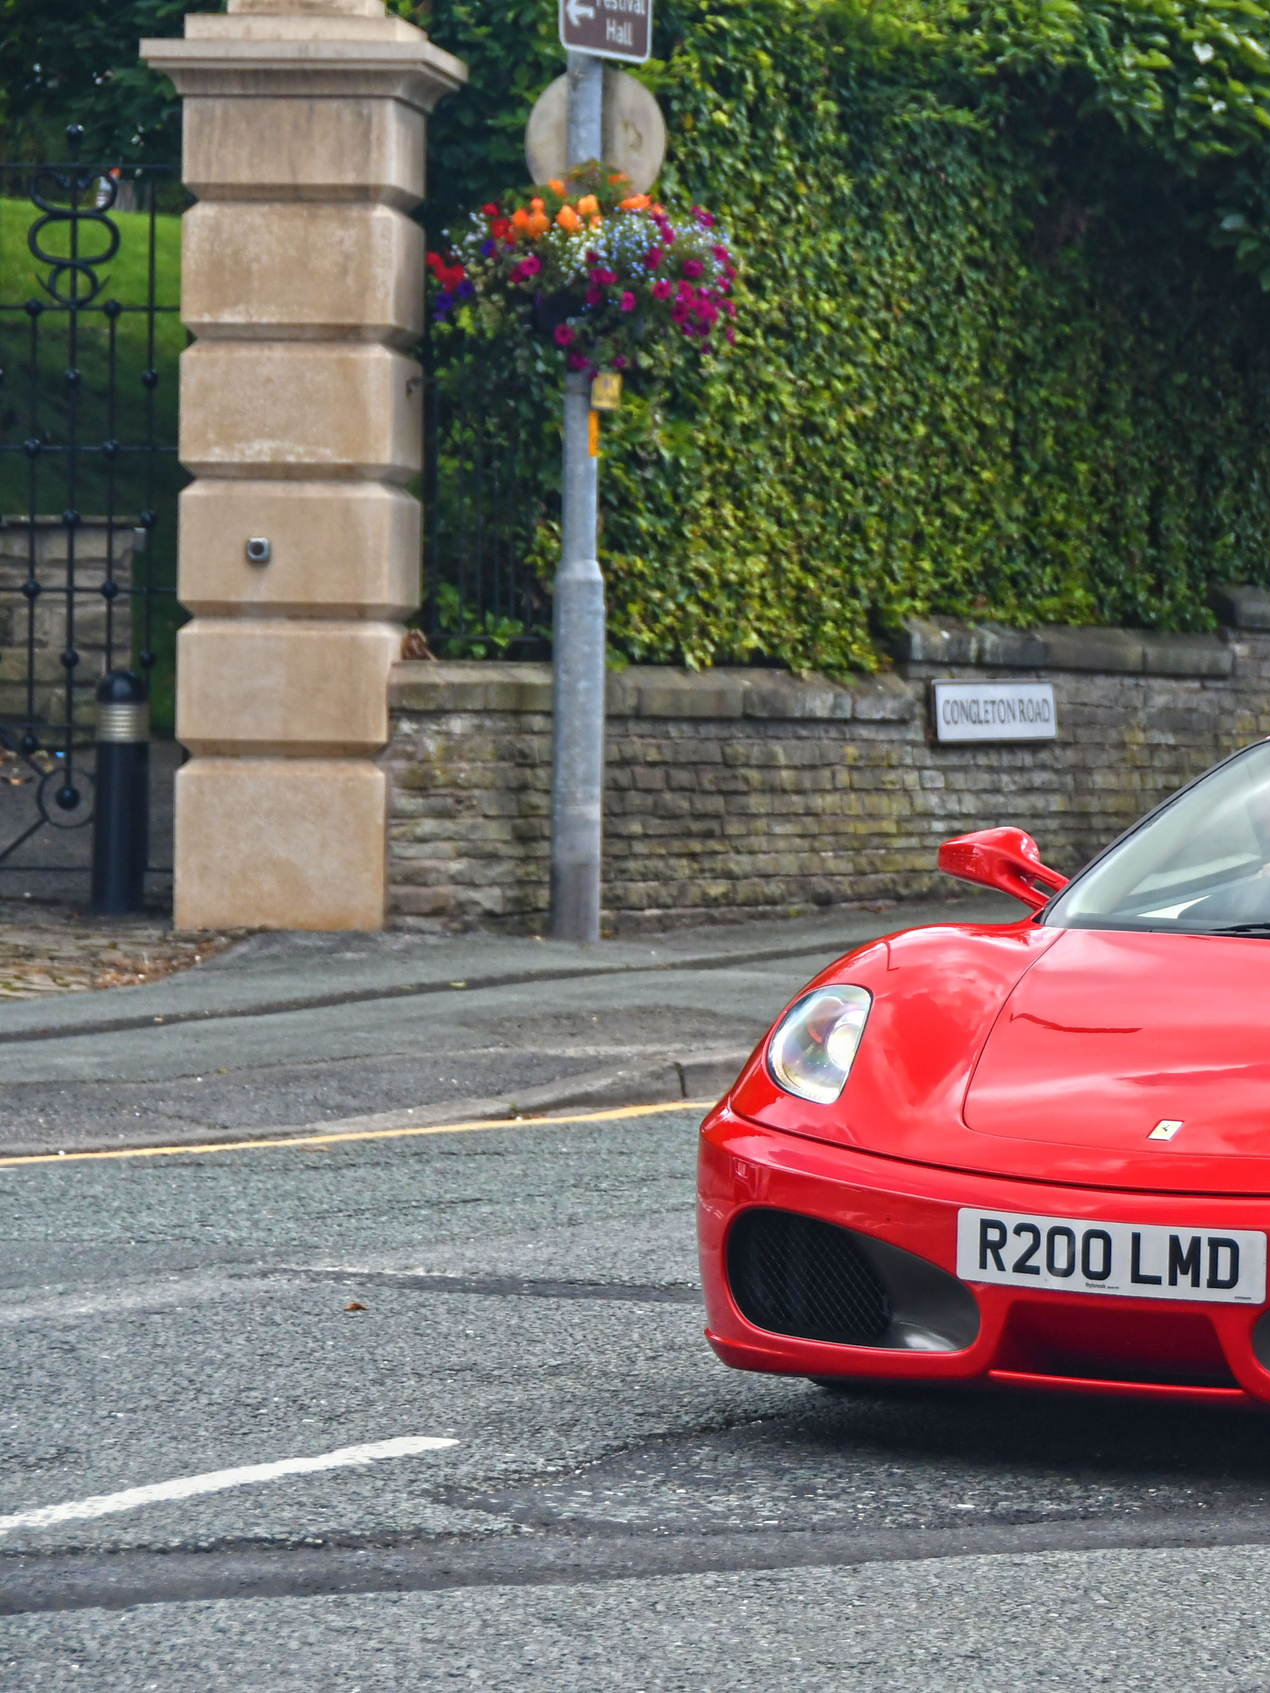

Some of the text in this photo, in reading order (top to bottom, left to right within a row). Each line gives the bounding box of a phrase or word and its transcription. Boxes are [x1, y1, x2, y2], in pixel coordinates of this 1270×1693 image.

[606, 18, 633, 46] Hall
[942, 698, 1050, 725] CONGLETON ROAD
[979, 1218, 1240, 1290] R200 LMD
